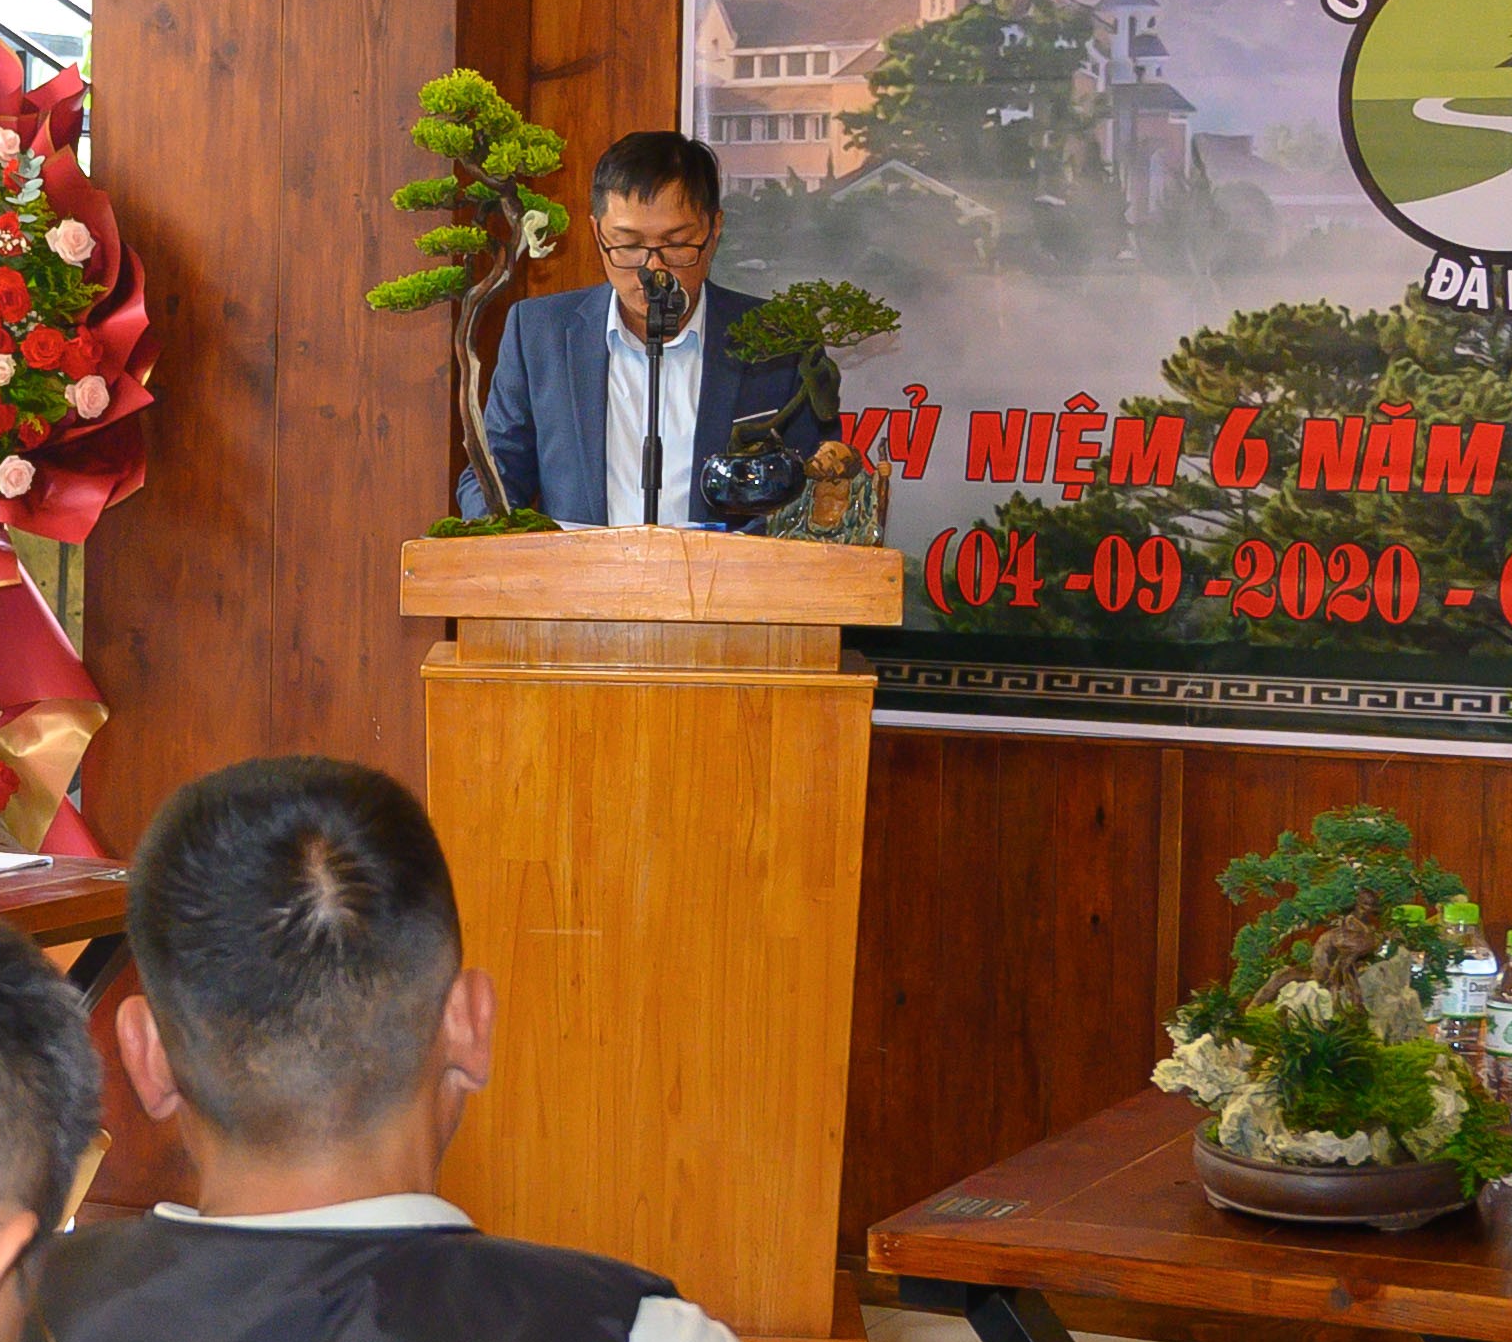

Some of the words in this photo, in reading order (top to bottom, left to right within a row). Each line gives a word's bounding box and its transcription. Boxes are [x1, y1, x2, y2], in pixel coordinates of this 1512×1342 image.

[1426, 254, 1490, 311] ĐÀ
[839, 383, 942, 480] KỶ
[965, 391, 1185, 502] NIỆM
[1210, 403, 1272, 491] 6
[1298, 401, 1506, 497] NĂM
[923, 526, 1046, 616] (04
